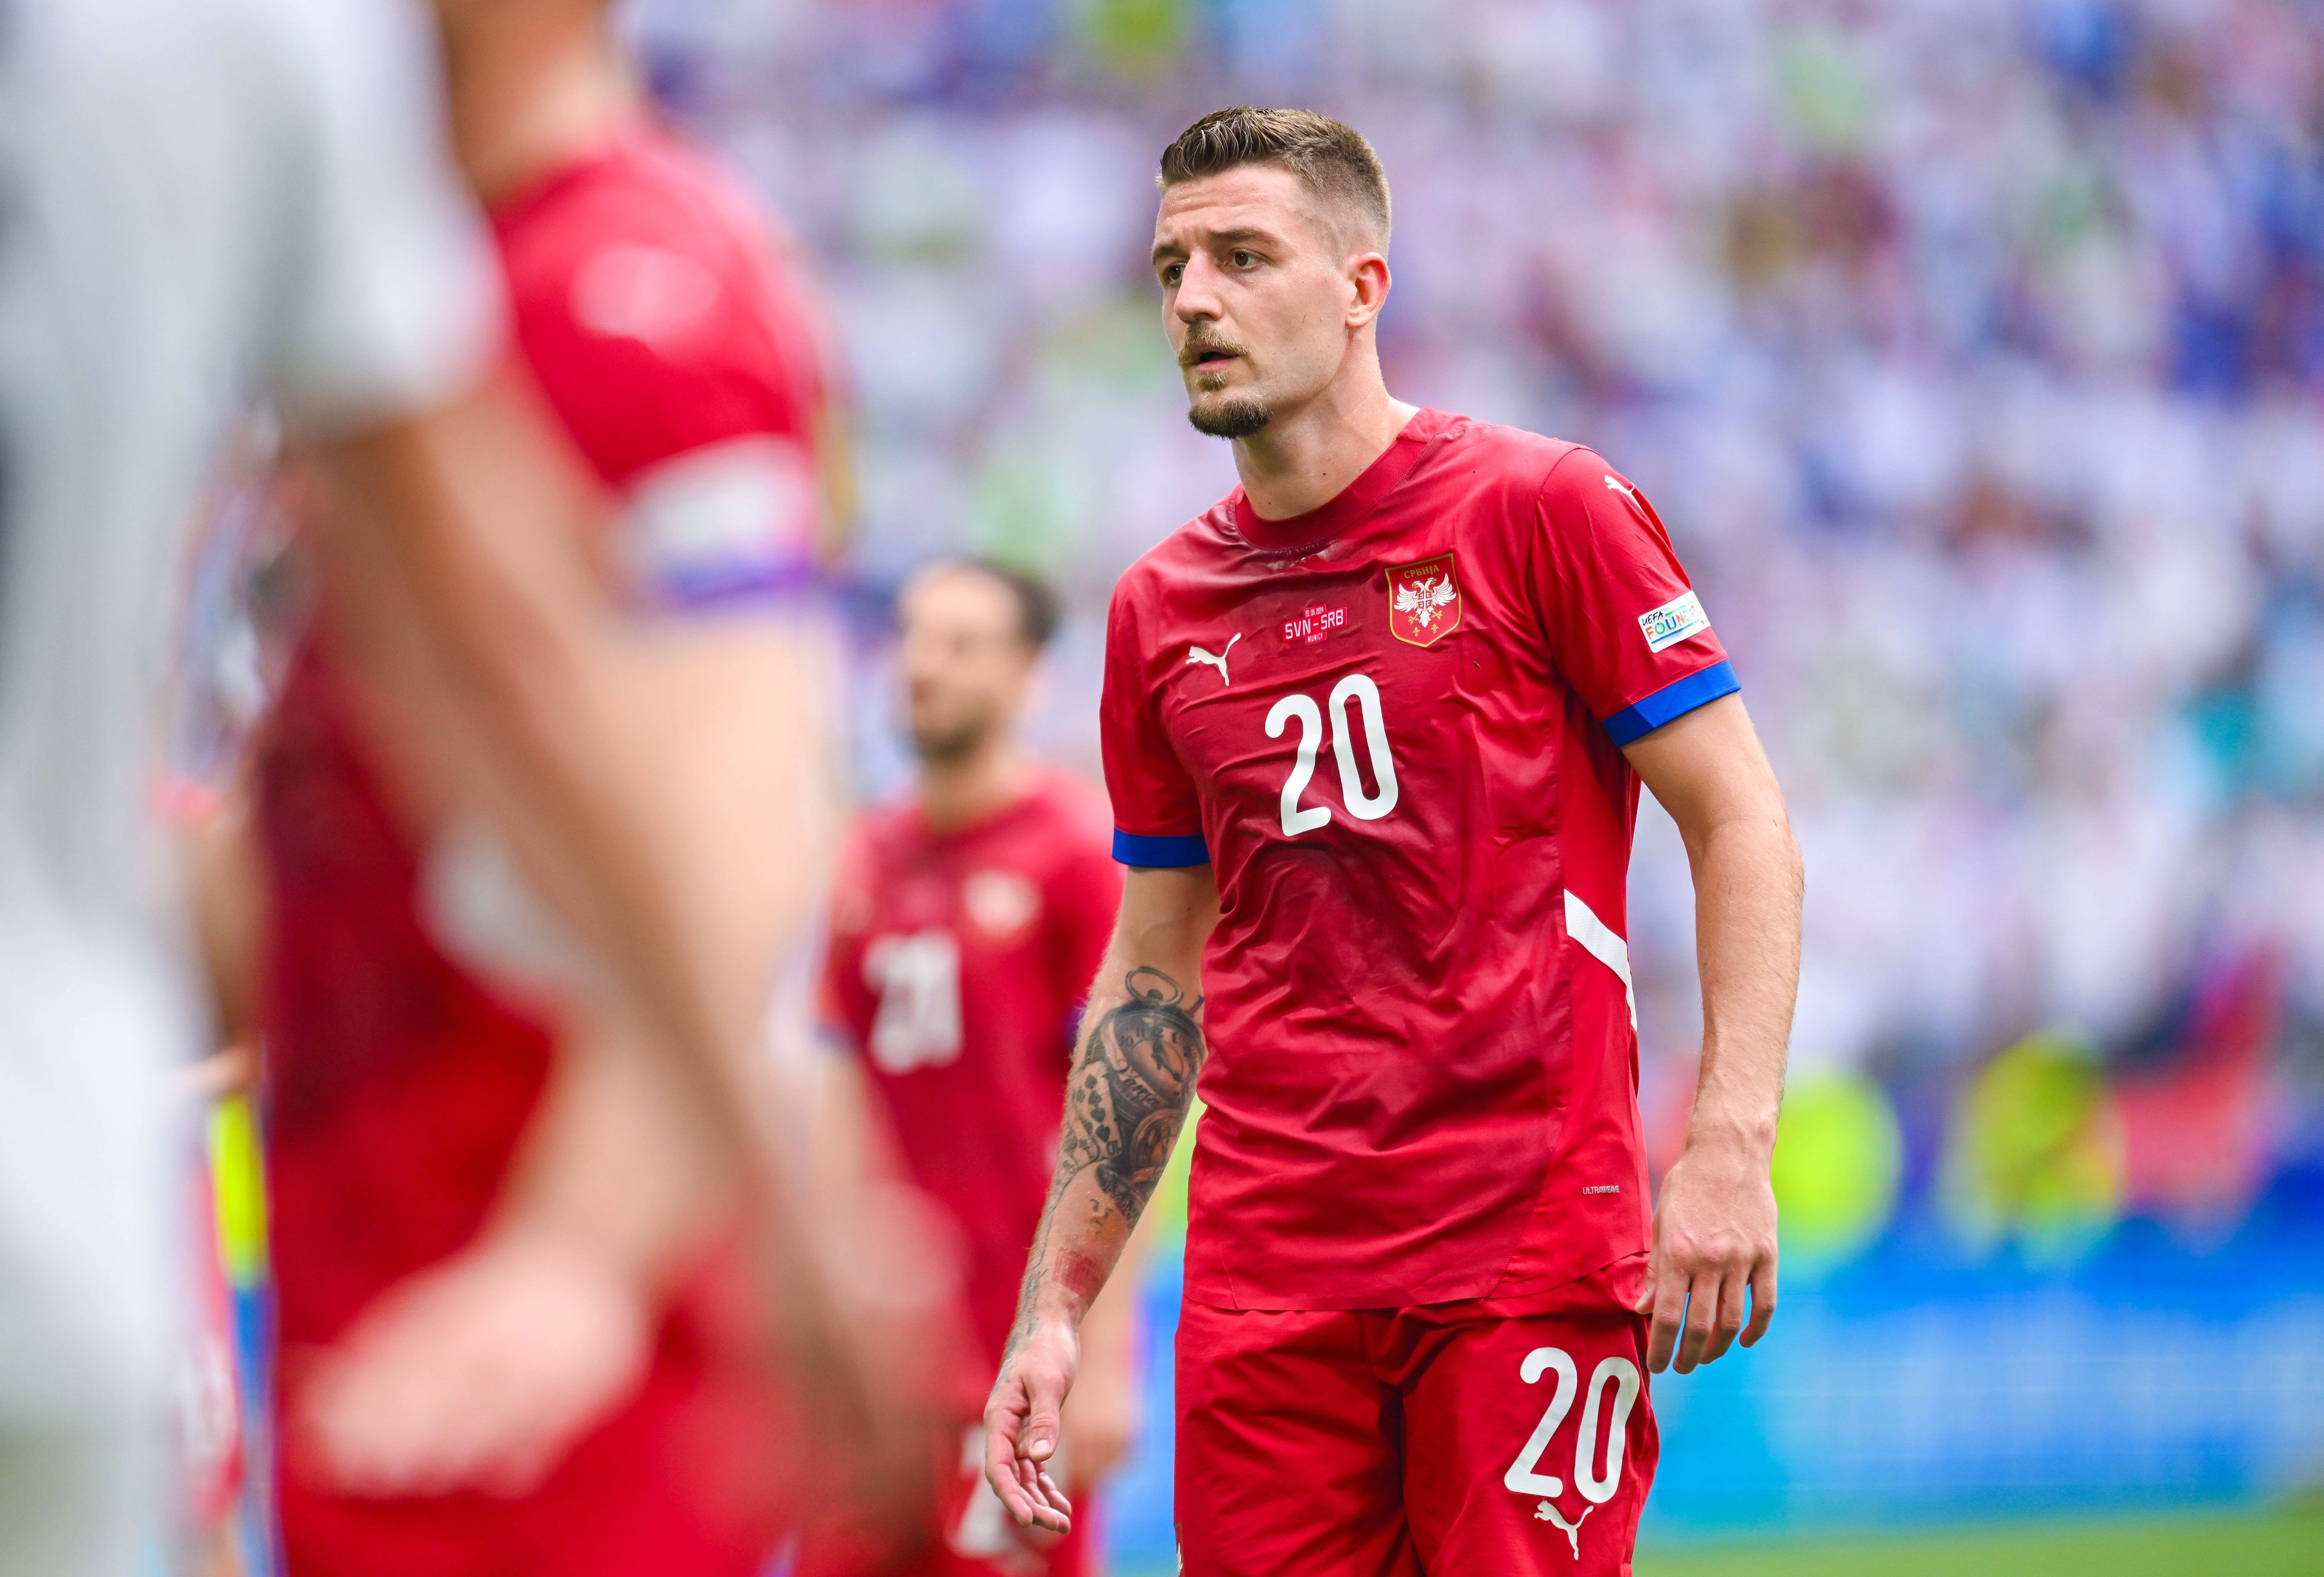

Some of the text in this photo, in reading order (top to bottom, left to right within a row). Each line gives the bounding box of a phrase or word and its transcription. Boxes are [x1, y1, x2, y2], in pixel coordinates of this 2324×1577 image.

[1404, 564, 1440, 579] СРБИЈА
[1642, 611, 1663, 626] UEFA
[1307, 632, 1324, 643] MUNICH
[1265, 674, 1398, 837] 20
[1582, 1185, 1620, 1195] ULTRAWEAVE
[1504, 1347, 1640, 1504] 20
